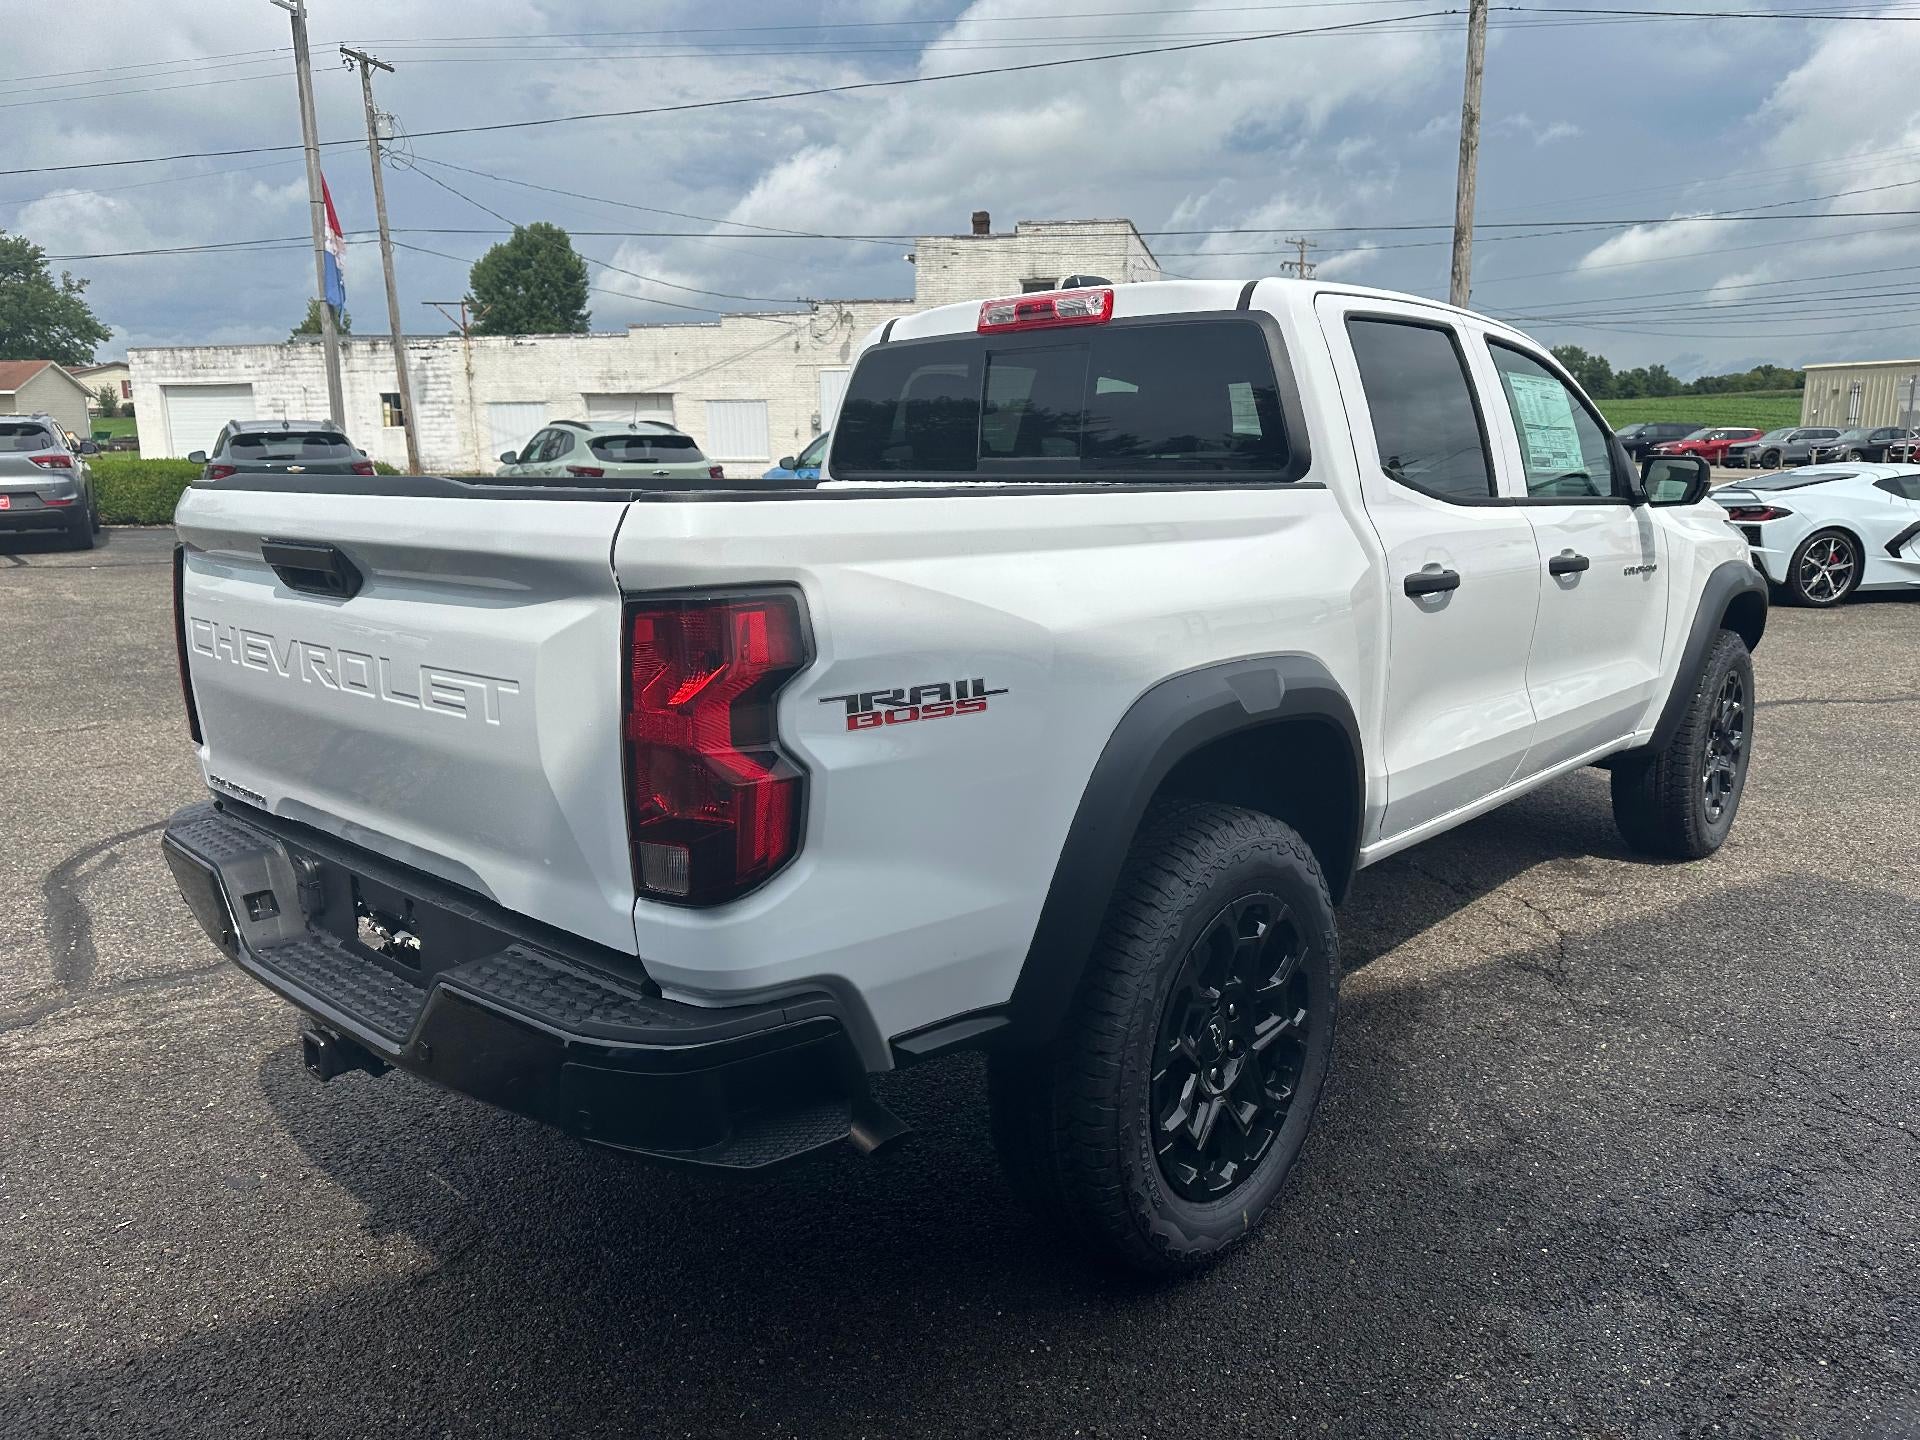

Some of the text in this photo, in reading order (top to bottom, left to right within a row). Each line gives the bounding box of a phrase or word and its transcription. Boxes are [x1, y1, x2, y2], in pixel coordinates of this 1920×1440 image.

[190, 616, 519, 725] CHEVROLET
[819, 678, 1009, 714] TRAIL
[846, 697, 987, 731] BOSS
